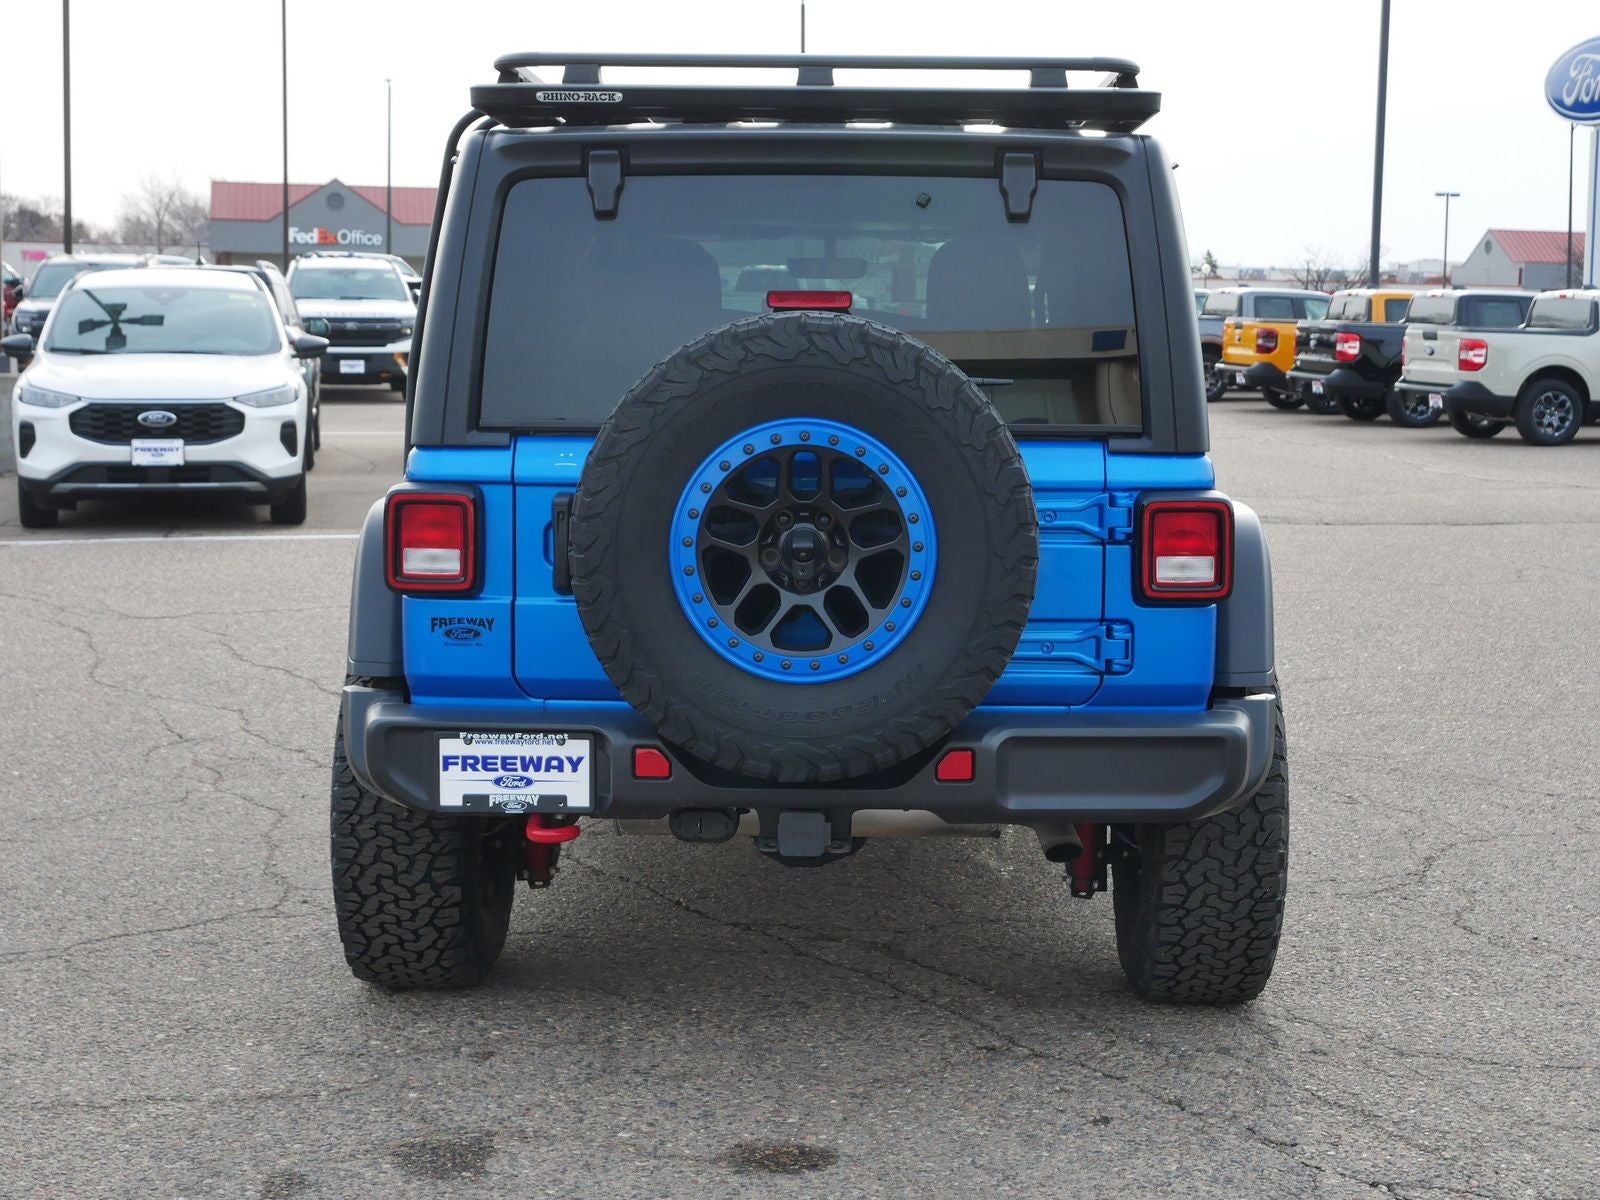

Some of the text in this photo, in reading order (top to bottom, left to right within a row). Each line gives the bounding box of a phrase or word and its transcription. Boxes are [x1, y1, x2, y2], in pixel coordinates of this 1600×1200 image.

[1562, 53, 1600, 106] For
[542, 92, 617, 101] RHINO-RACK
[288, 227, 382, 246] FedEx Office
[431, 617, 495, 632] FREEWAY
[449, 628, 475, 639] Ford
[459, 732, 569, 740] FreewayFord.net
[474, 738, 555, 746] www.freewayford.net
[442, 755, 584, 773] FREEWAY
[499, 776, 527, 787] Ford
[489, 794, 540, 807] FREEWAY
